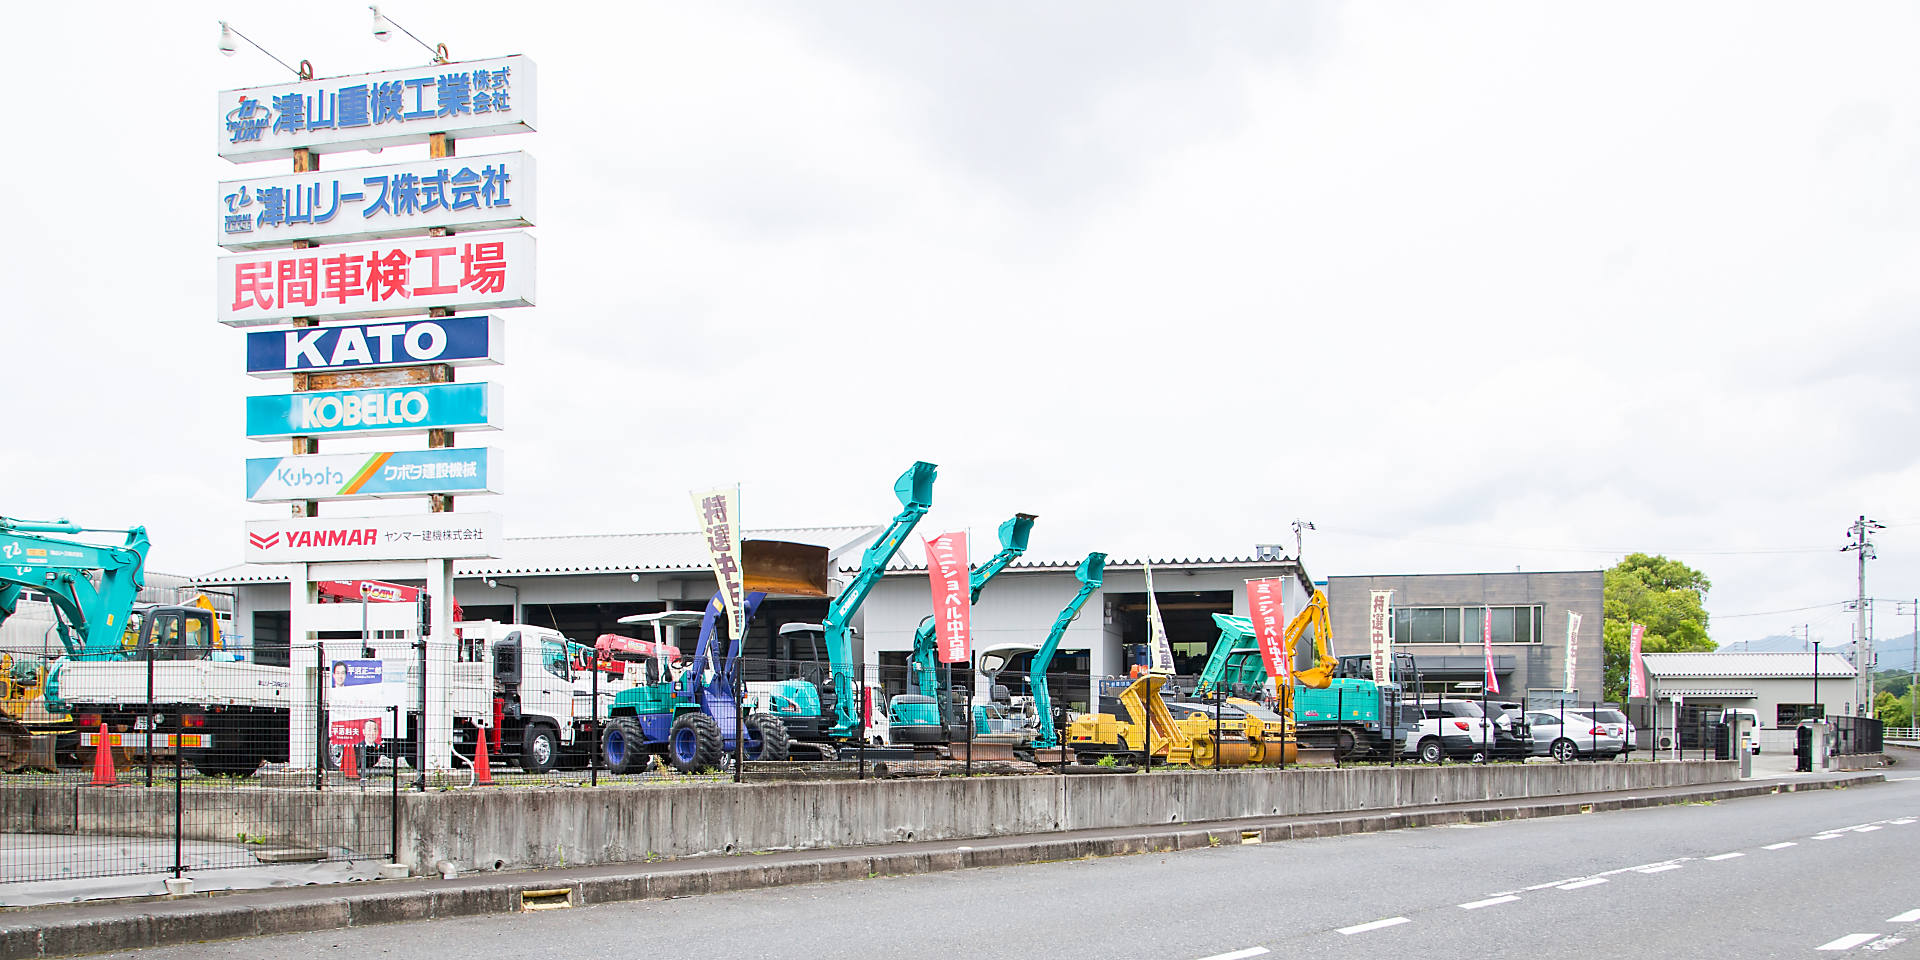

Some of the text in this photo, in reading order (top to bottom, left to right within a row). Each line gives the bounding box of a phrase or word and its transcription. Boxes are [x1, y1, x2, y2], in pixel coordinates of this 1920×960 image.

[472, 66, 511, 91] 株式
[273, 72, 471, 135] 津山重機工業
[472, 90, 511, 114] 会社
[256, 164, 512, 228] 津山リース株式会社
[232, 241, 507, 312] 民間車検工場
[285, 322, 447, 369] KATO
[302, 391, 429, 429] KOBELCO
[278, 466, 343, 487] Kubota
[383, 461, 477, 482] クボタ建設機械
[285, 529, 378, 548] YANMAR
[384, 528, 484, 542] ヤンマー建機株式会社
[937, 537, 966, 662] ミニショベル中古車
